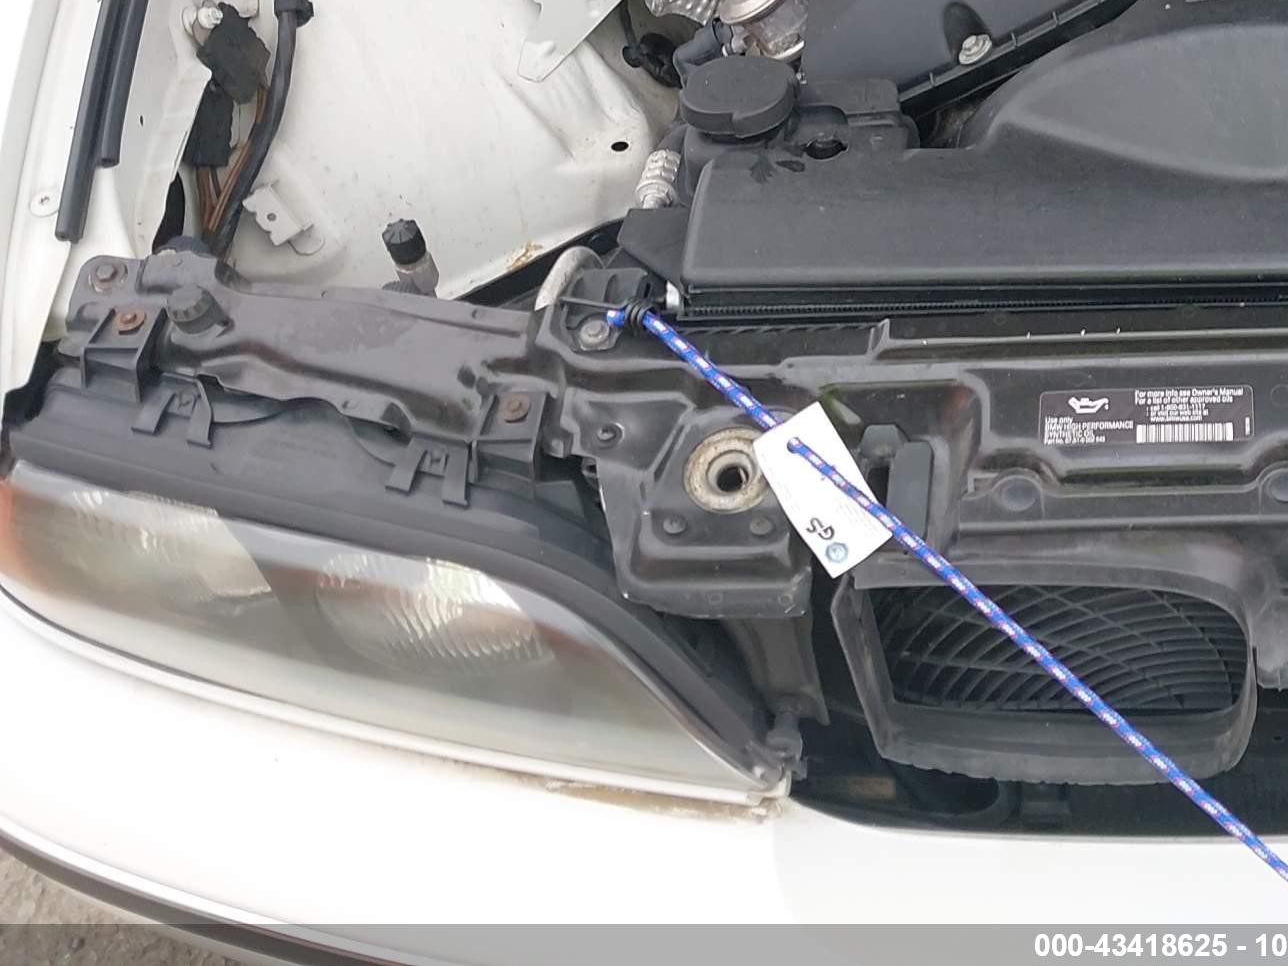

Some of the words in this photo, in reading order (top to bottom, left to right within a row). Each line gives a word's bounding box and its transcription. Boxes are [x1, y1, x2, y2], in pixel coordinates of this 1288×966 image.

[1135, 389, 1146, 398] For
[1192, 388, 1218, 396] Owner's
[1219, 387, 1244, 396] Manual
[1135, 396, 1146, 405] For
[1082, 420, 1134, 430] PERFORMANCE
